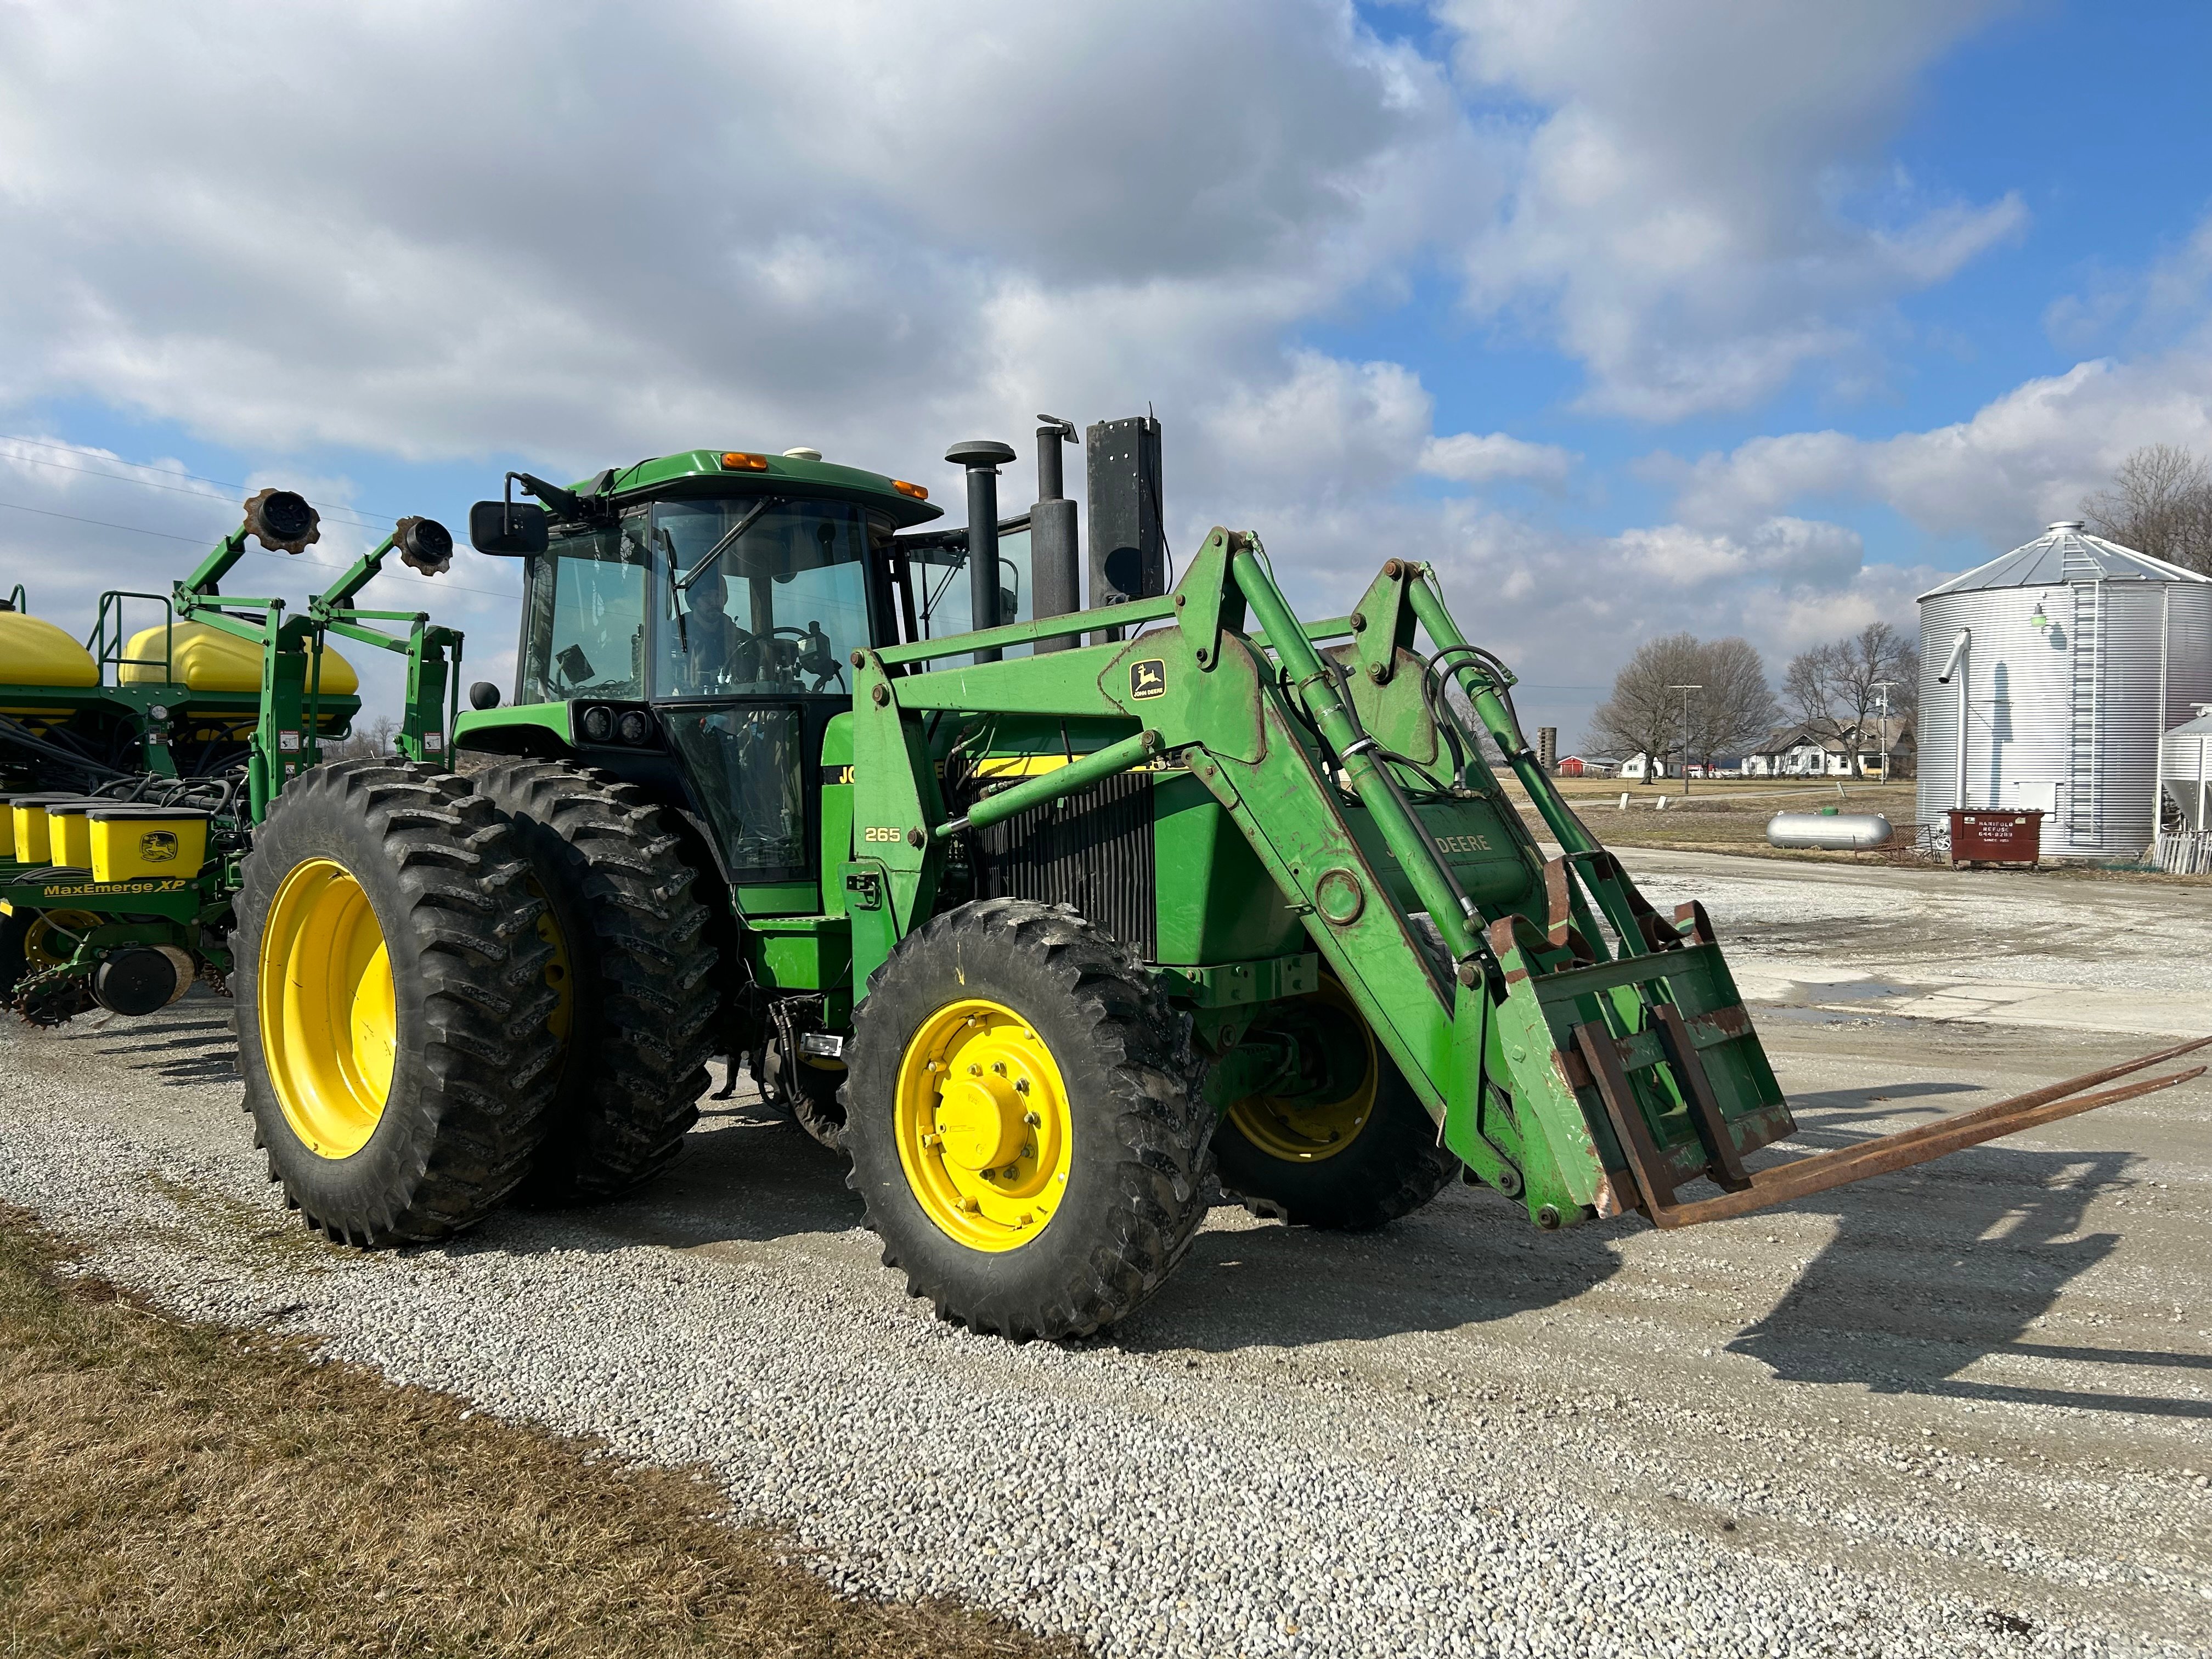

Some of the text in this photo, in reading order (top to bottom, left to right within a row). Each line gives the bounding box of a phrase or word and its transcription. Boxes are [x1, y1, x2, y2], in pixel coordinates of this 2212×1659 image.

[865, 827, 900, 842] 265
[1434, 834, 1492, 854] DEERE
[44, 880, 186, 895] MaxEmerge XP
